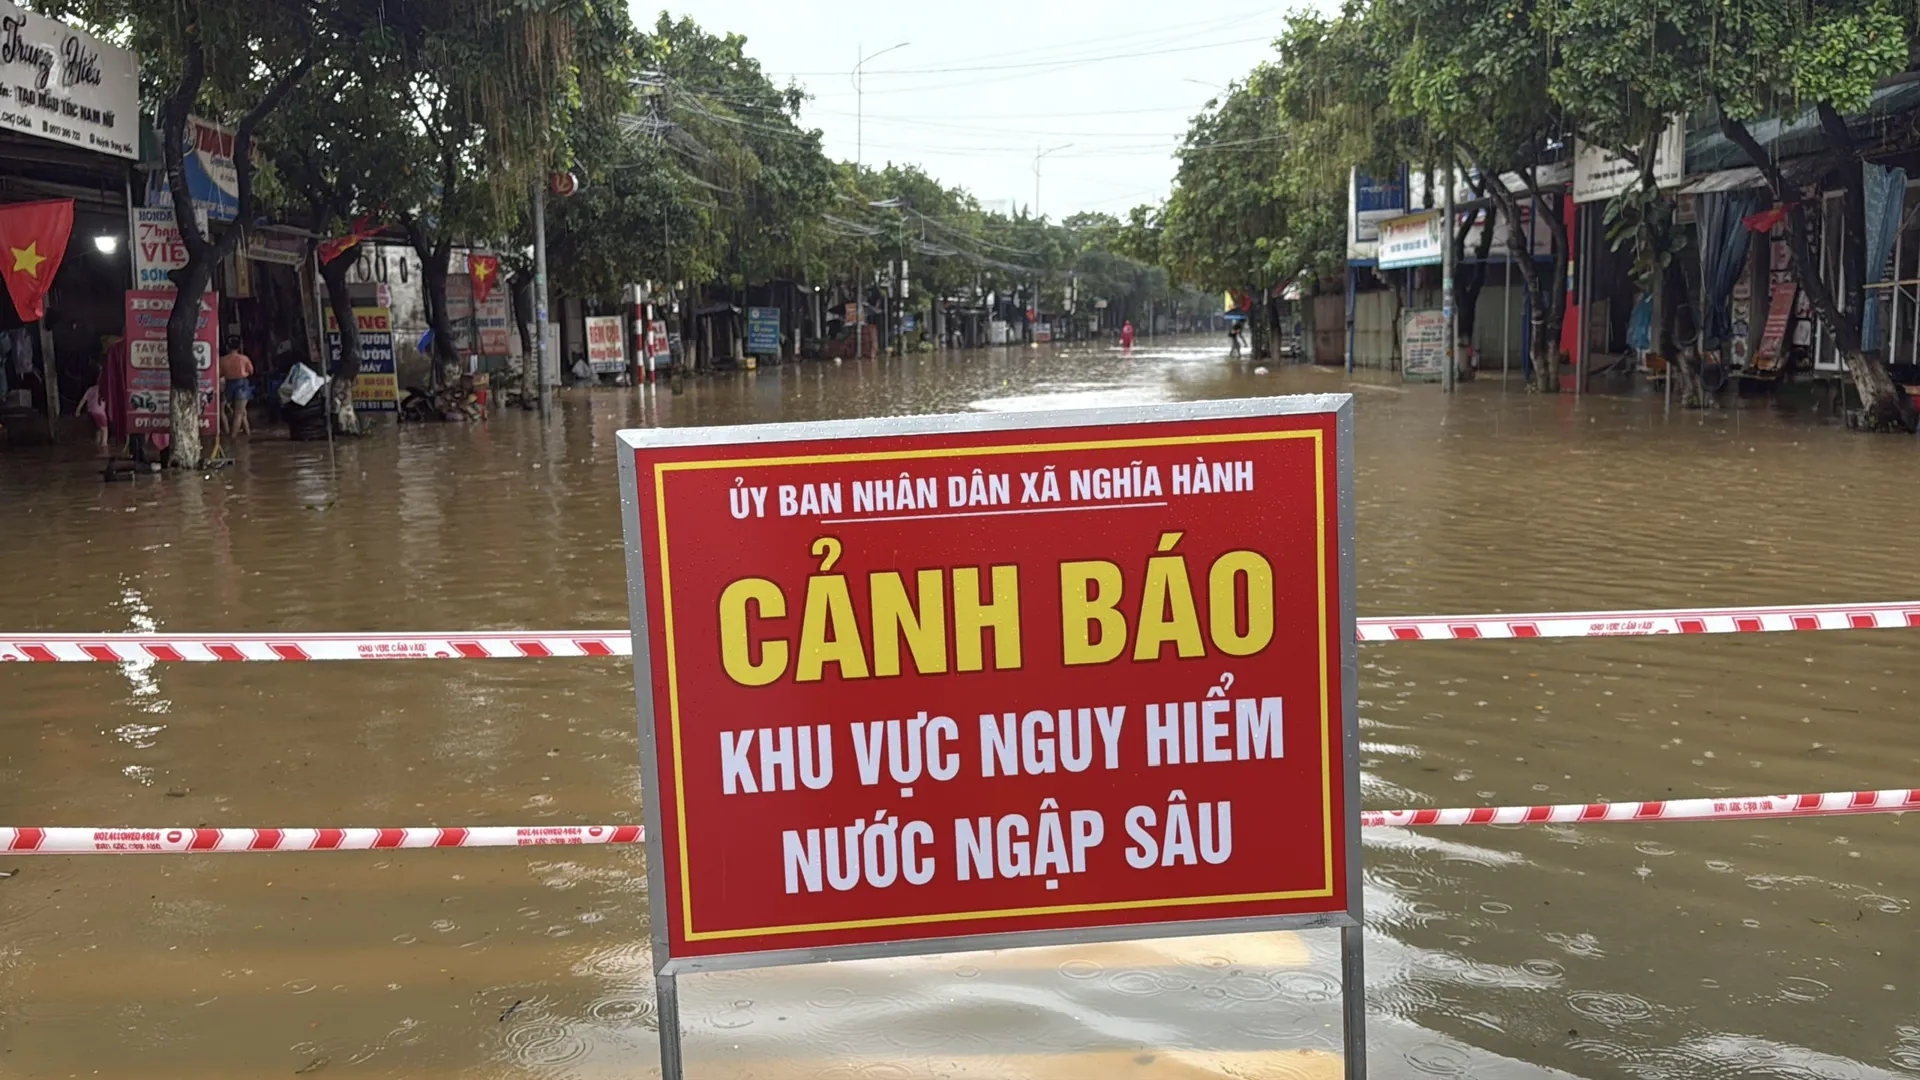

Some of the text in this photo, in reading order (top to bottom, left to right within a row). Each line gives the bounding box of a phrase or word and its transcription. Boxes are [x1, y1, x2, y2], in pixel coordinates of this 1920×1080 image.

[139, 211, 173, 220] HONDA
[730, 456, 1254, 520] ỦY BAN NHÂN DÂN XÃ NGHĨA HÀNH
[718, 531, 1275, 687] CẢNH BÁO
[719, 672, 1284, 798] KHU VỰC NGUY HIỂM
[782, 789, 1233, 894] NƯỚC NGẬP SÂU
